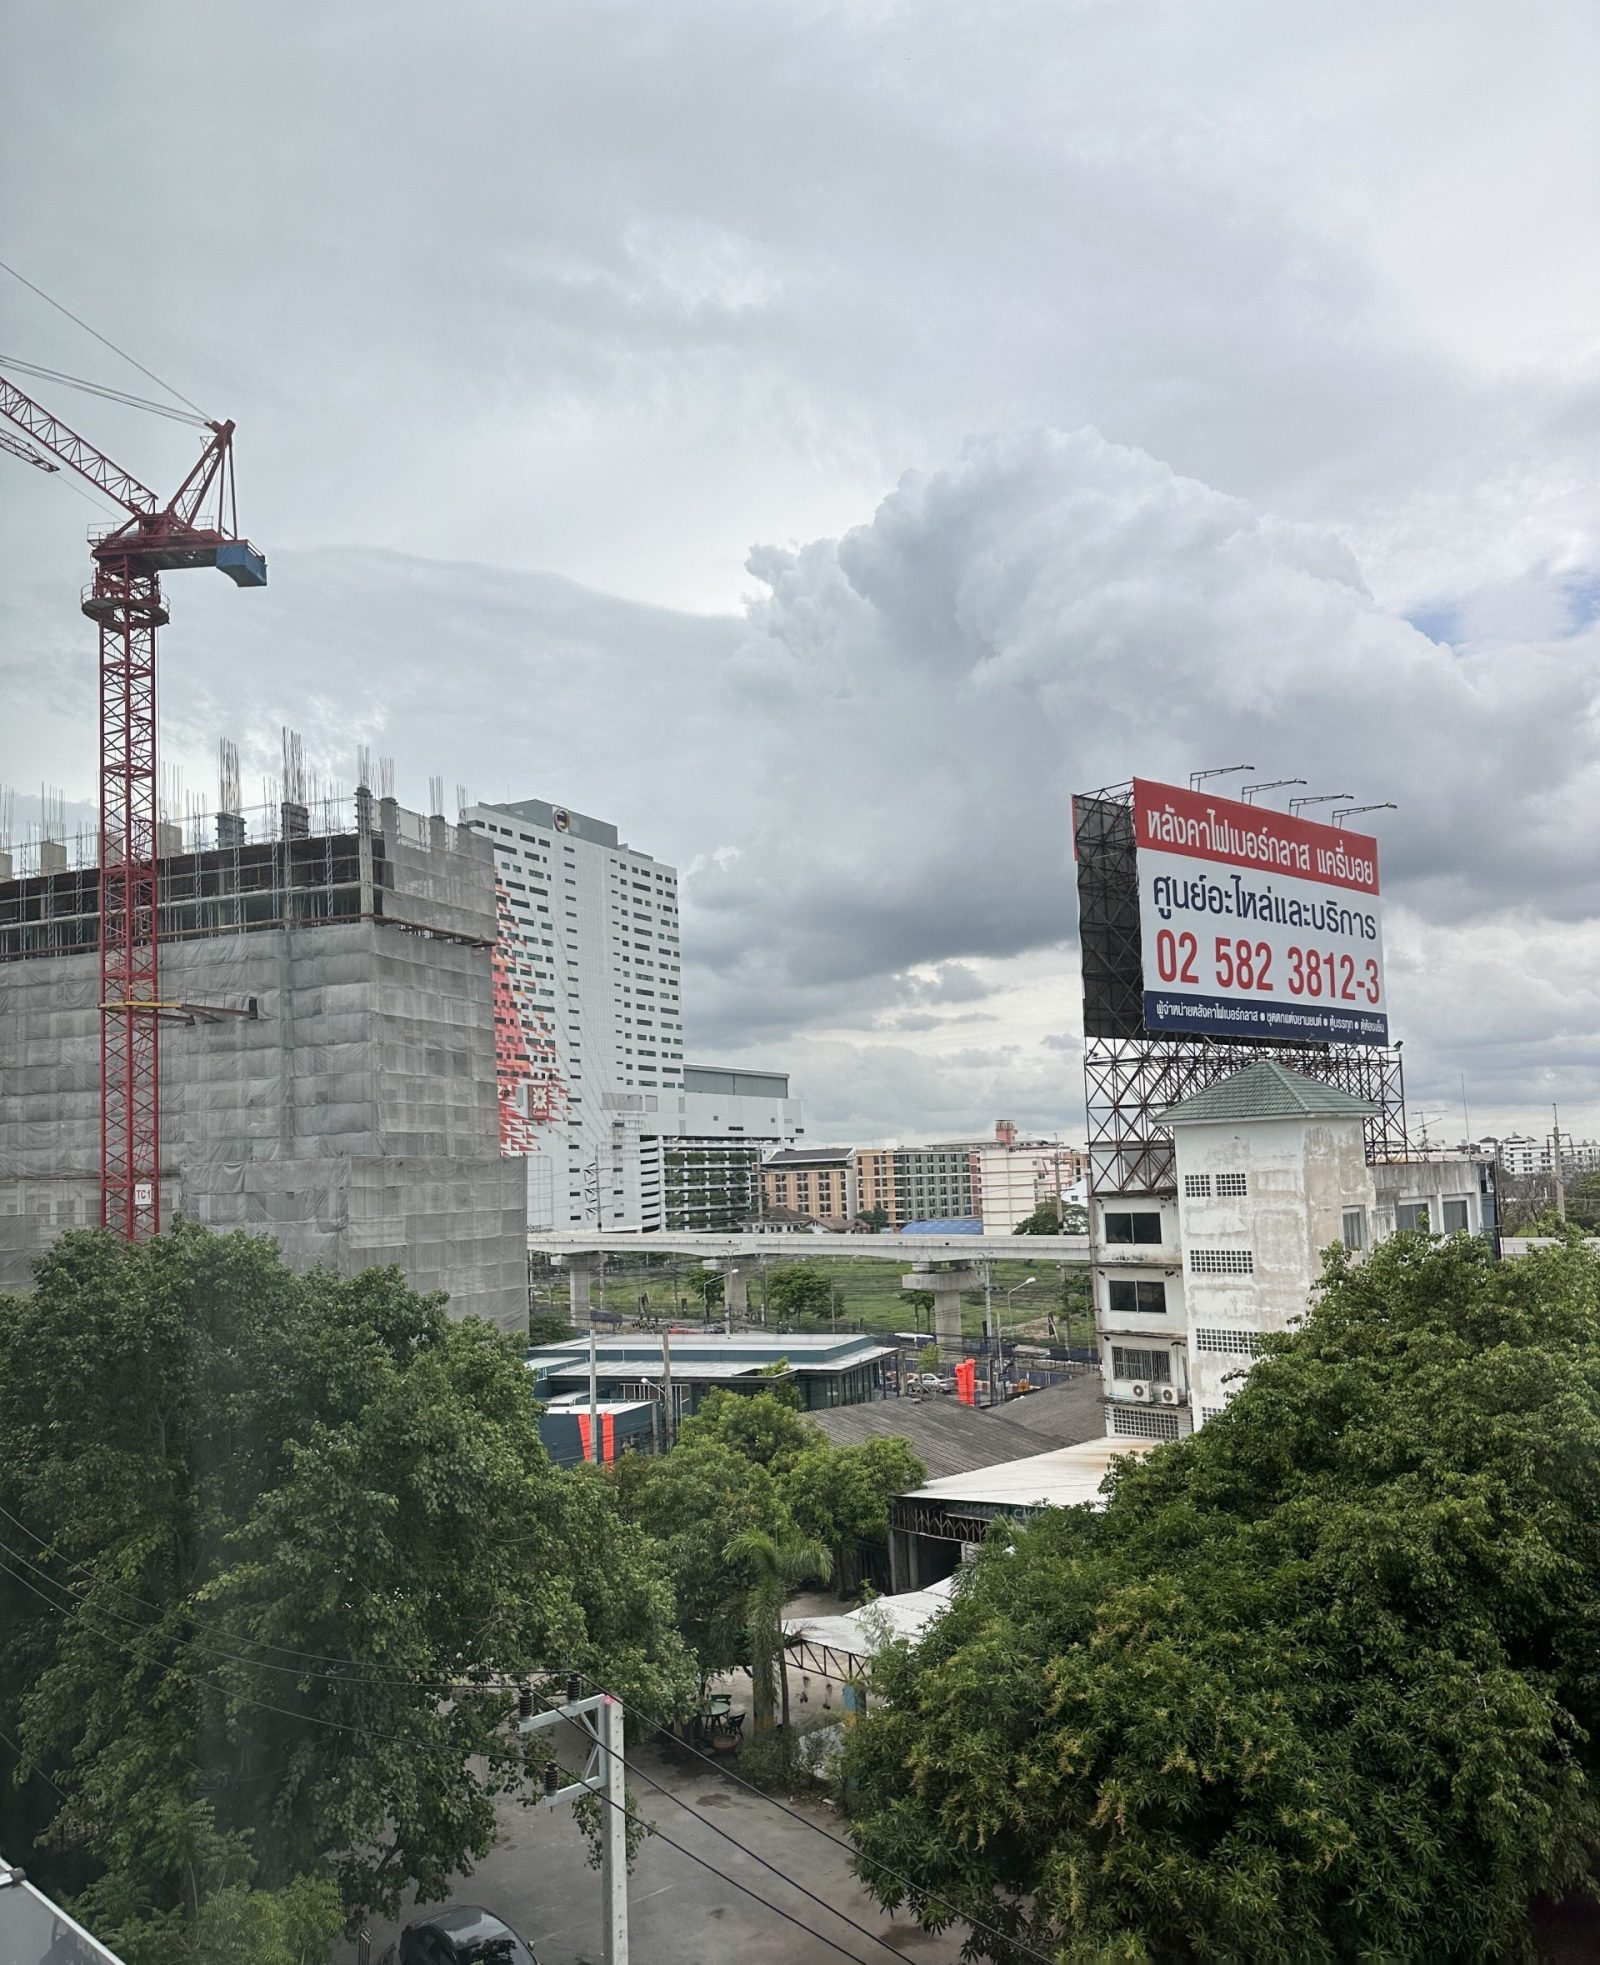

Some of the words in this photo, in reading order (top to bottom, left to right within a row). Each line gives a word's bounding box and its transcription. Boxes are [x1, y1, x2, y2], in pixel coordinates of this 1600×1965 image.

[1147, 804, 1310, 871] หลังคาไฟเบอร์กลาส
[1317, 840, 1373, 885] แครี่บอย
[1153, 874, 1376, 940] ศูนย์อะไหล่และบริการ
[1157, 929, 1199, 984] 02
[1215, 937, 1273, 991] 582
[1288, 947, 1379, 1004] 3812-3
[136, 1189, 150, 1200] TC1
